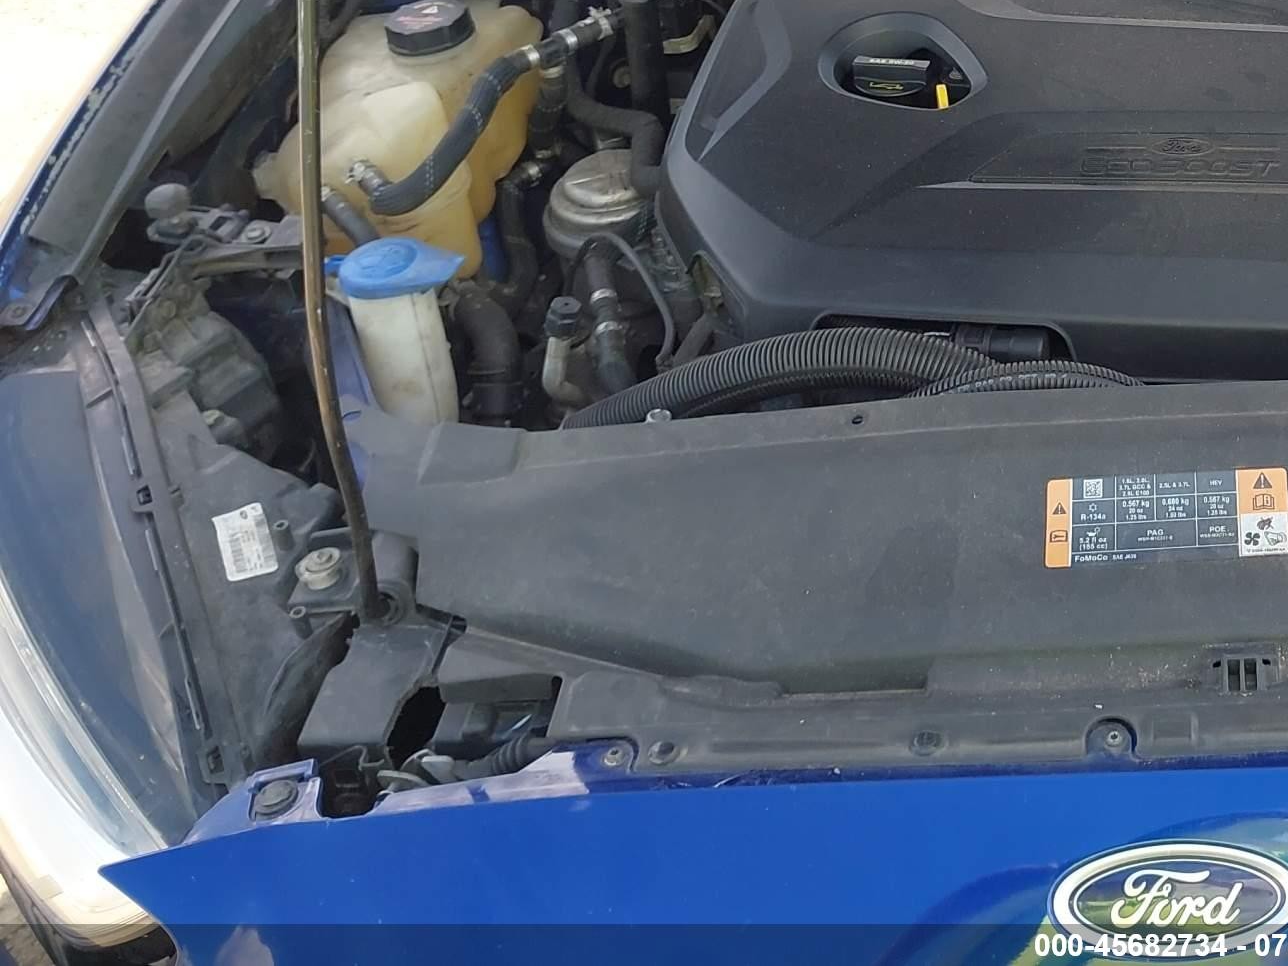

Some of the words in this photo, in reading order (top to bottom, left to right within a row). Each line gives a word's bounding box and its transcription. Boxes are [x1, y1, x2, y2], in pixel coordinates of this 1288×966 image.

[1122, 499, 1140, 508] 0.567
[1141, 499, 1150, 508] kg
[1180, 497, 1190, 506] kg
[1203, 495, 1220, 504] 0.567
[1221, 495, 1230, 504] kg
[1080, 513, 1106, 521] R-134a
[1146, 528, 1164, 536] PAG
[1209, 525, 1226, 533] POE
[1074, 554, 1108, 563] FoMoCo
[1110, 869, 1243, 928] Ford
